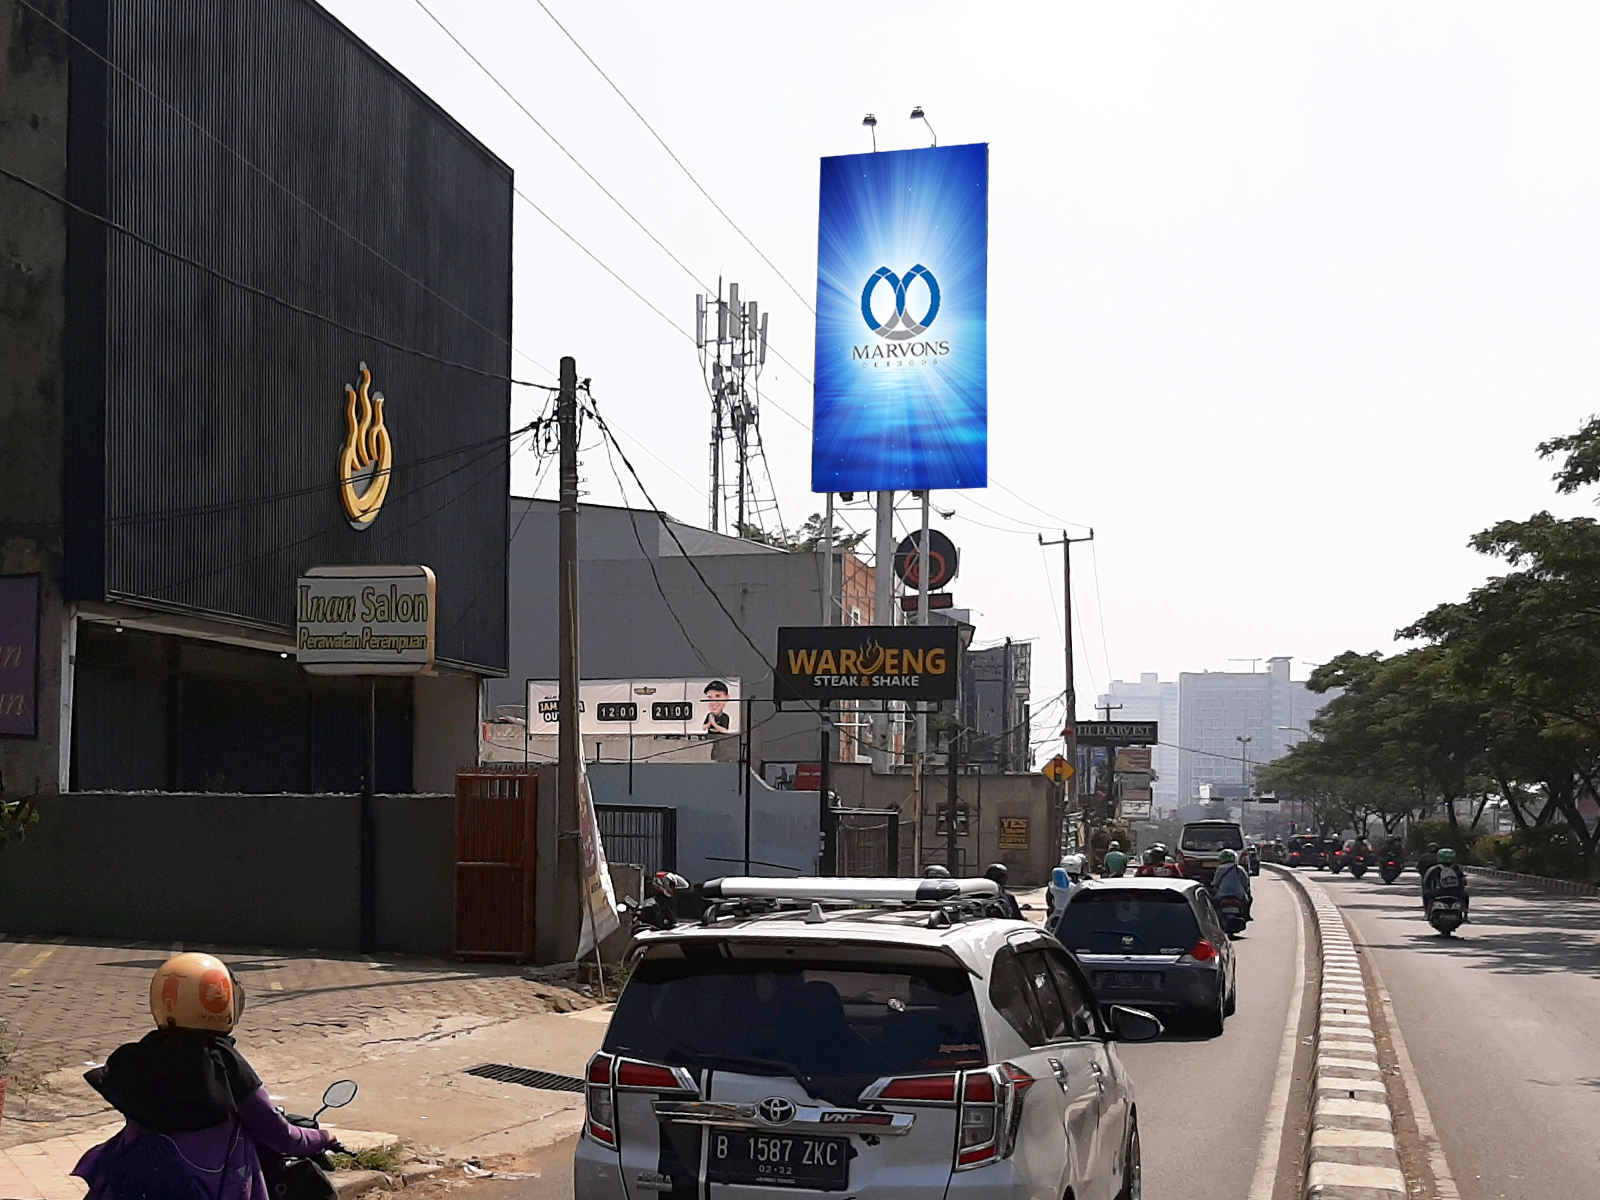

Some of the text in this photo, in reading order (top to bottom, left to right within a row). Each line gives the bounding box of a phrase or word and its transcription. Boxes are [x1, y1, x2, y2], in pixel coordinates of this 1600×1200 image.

[852, 340, 950, 360] MARVONS
[299, 584, 428, 623] Inan Salon
[299, 627, 427, 654] Perawatan Perempuan
[813, 675, 919, 687] STEAK & SHAKE
[655, 706, 690, 717] 21:00
[717, 1136, 838, 1166] B 1587 ZKC
